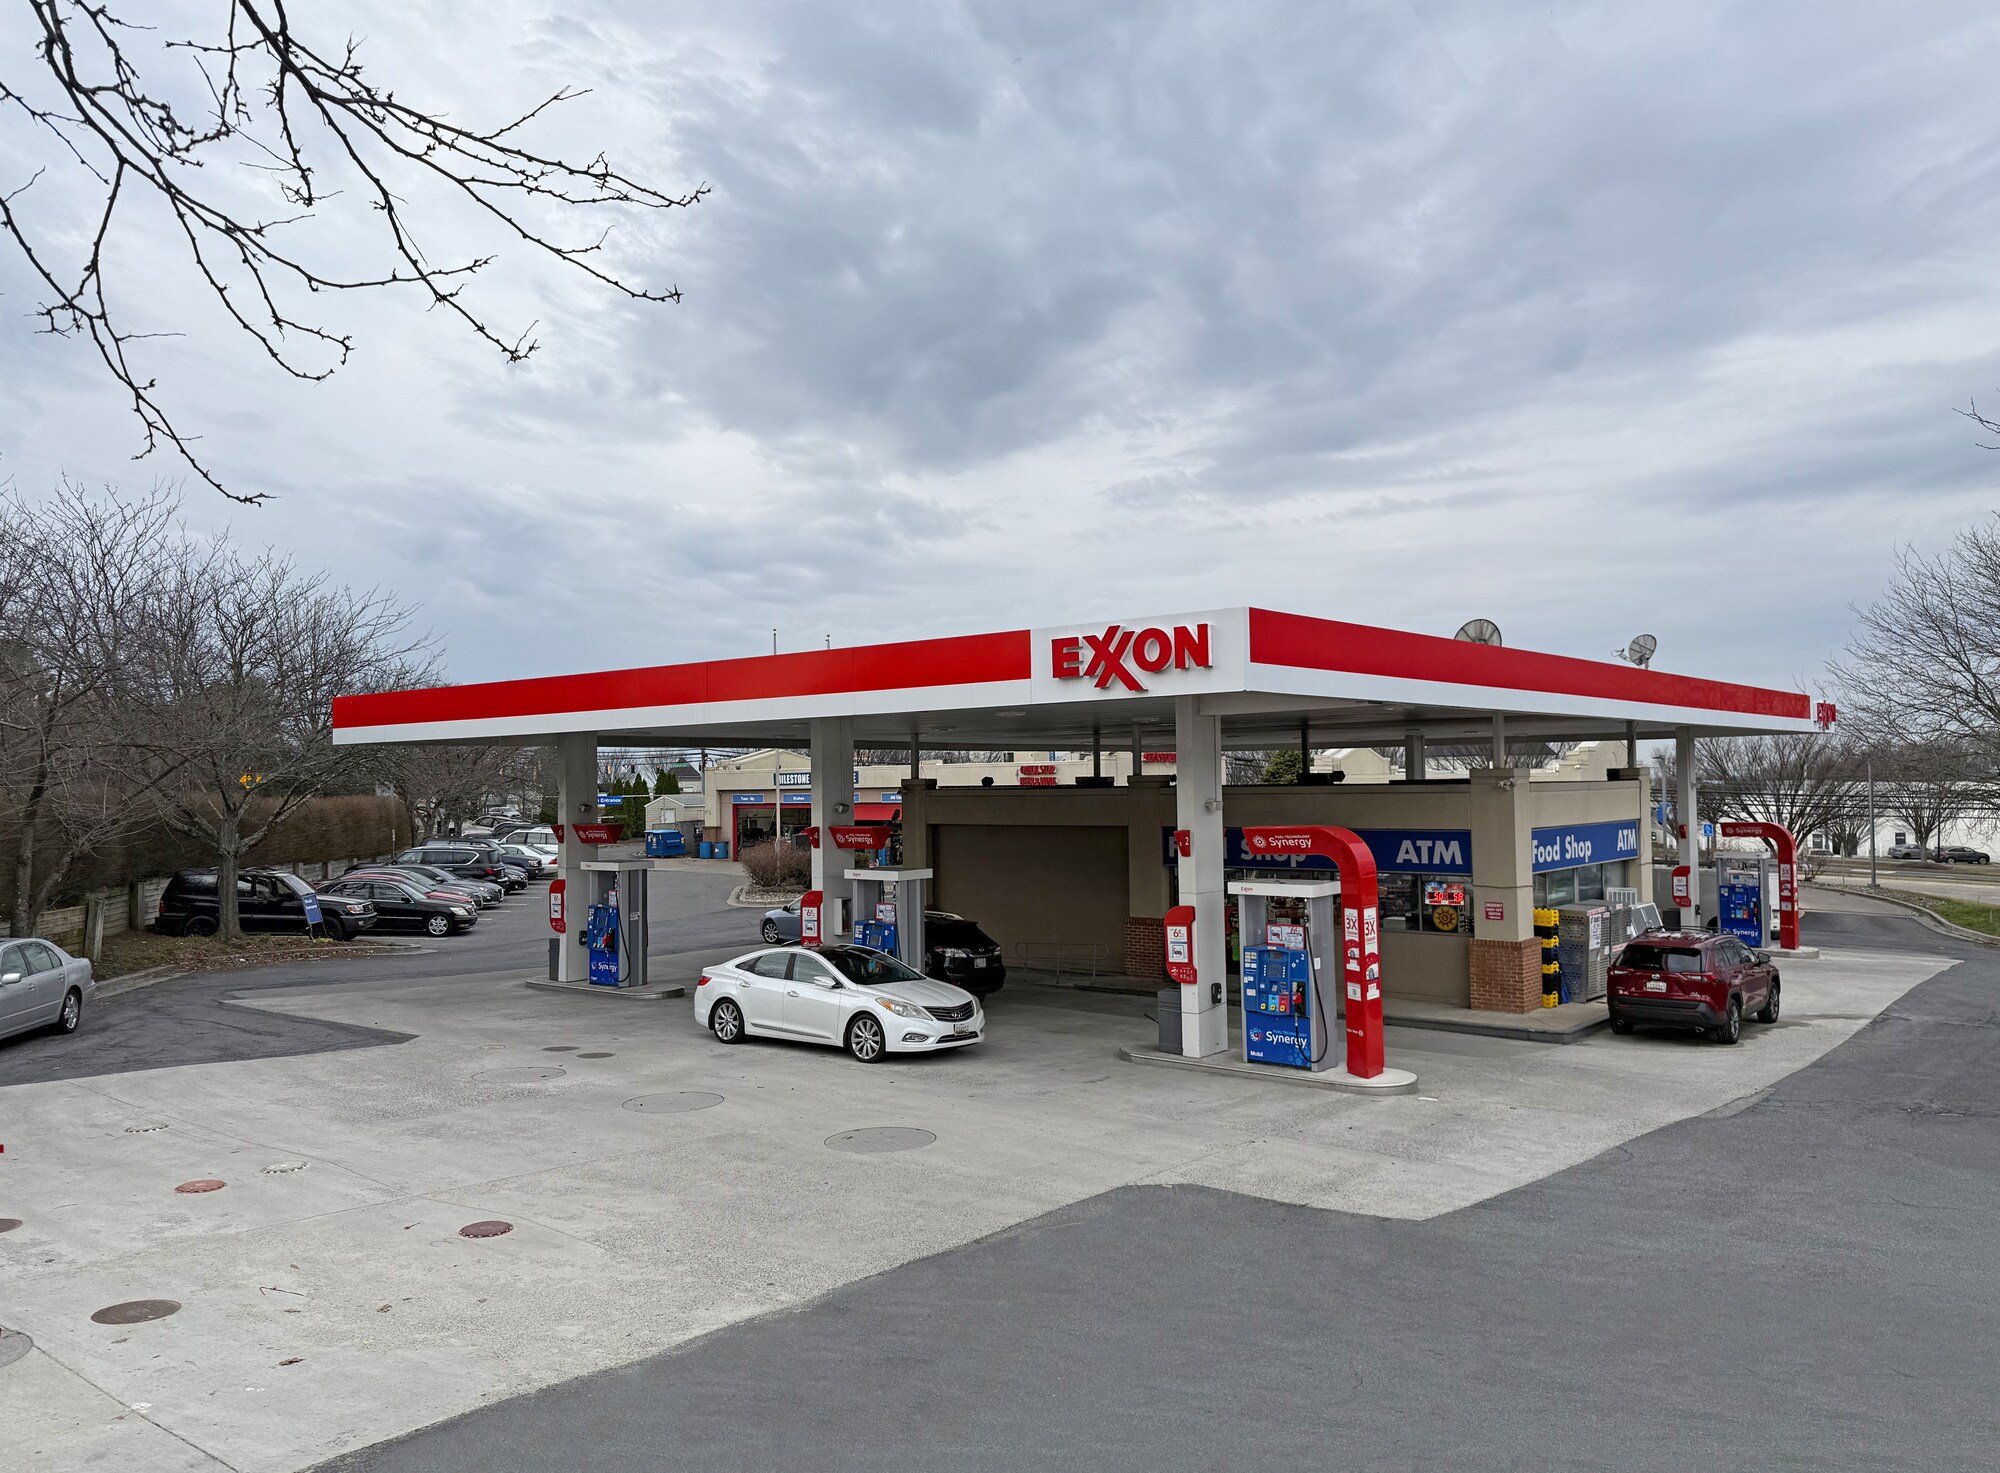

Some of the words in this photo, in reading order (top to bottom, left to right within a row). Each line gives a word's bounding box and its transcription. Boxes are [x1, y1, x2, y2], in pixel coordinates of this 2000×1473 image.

[1051, 623, 1213, 691] EXXON
[778, 773, 810, 785] ILESTONE
[845, 834, 873, 845] Synergy
[1268, 837, 1312, 848] Synergy
[1532, 836, 1561, 864] Food
[1565, 834, 1592, 862] Shop
[1616, 828, 1638, 851] ATM
[1395, 839, 1464, 865] ATM
[1346, 918, 1357, 931] 3X
[1365, 920, 1376, 936] 3X
[1732, 928, 1759, 937] Synergy
[1266, 1031, 1307, 1049] Synergy
[1250, 1050, 1264, 1058] Mobil
